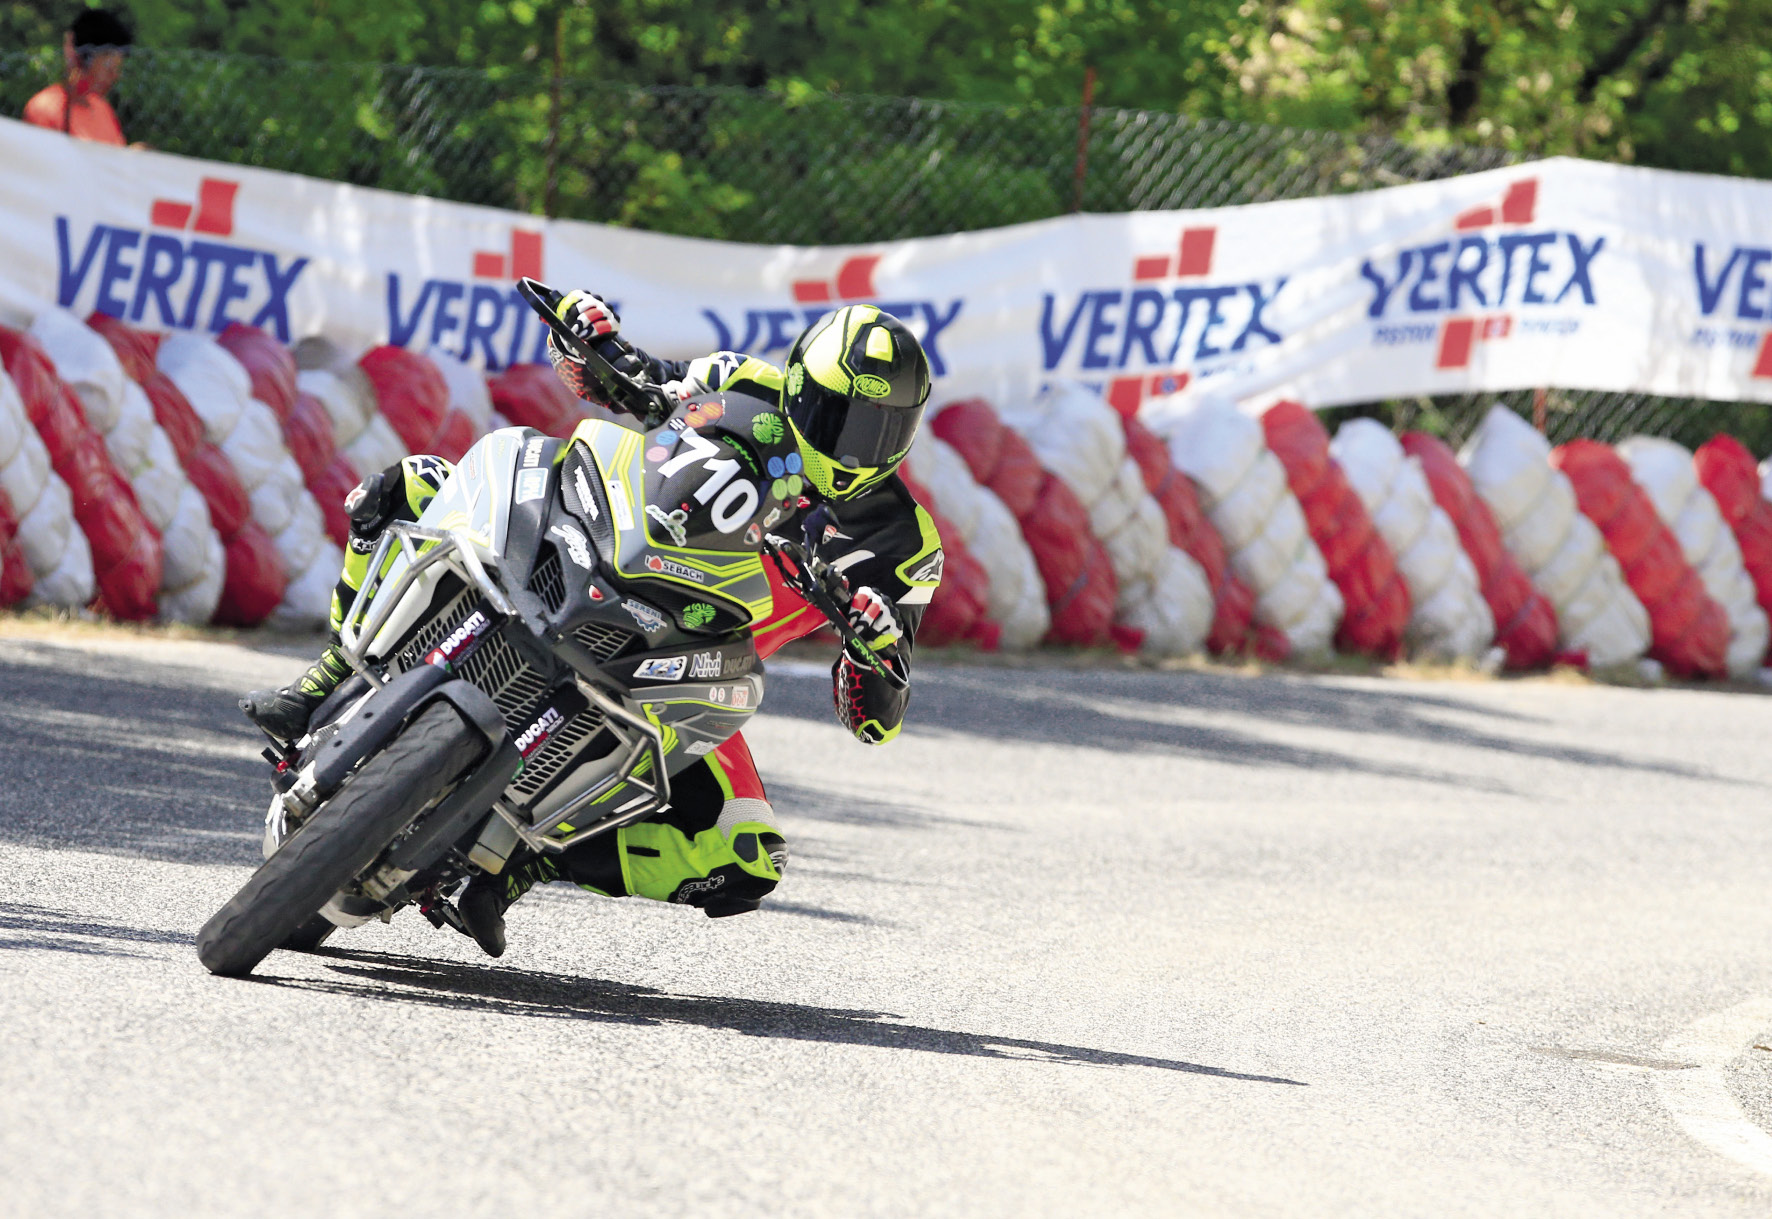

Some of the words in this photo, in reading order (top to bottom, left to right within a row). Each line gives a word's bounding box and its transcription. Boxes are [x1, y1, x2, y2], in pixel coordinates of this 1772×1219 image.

[56, 216, 309, 343] VERTEX
[1362, 232, 1606, 317] VERTEX
[1040, 276, 1292, 369] VERTEX
[856, 376, 888, 395] PREMIER
[657, 426, 759, 534] 710
[662, 560, 705, 582] SEBACH
[440, 611, 485, 656] DUCATI
[688, 650, 722, 678] Nivi
[514, 707, 559, 752] DUCATI
